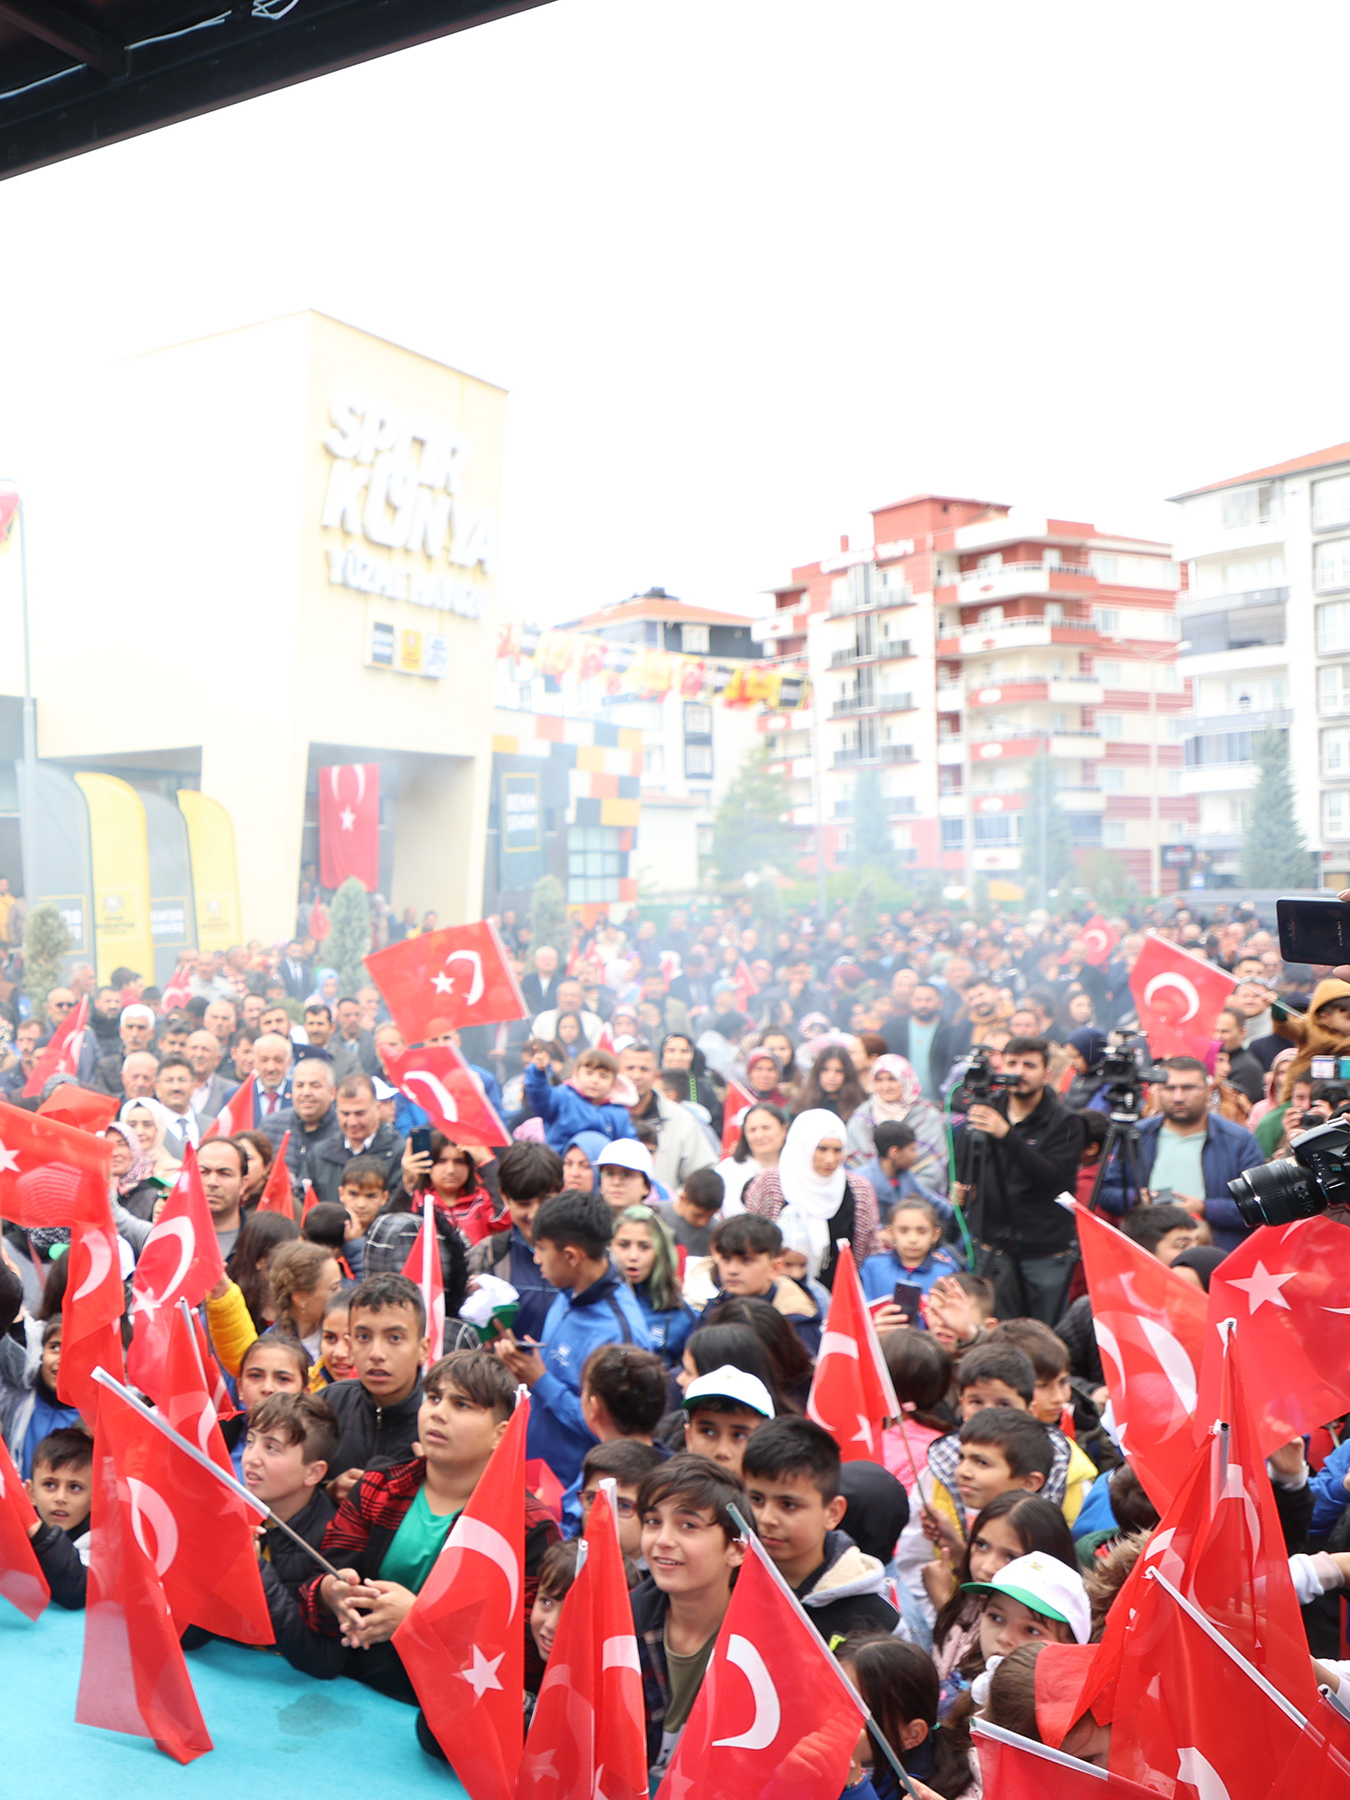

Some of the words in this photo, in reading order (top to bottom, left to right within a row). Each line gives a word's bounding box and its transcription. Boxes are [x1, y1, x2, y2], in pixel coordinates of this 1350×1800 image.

[321, 391, 468, 496] SPOR
[320, 454, 497, 575] KONYA
[323, 543, 407, 602] YÜZME
